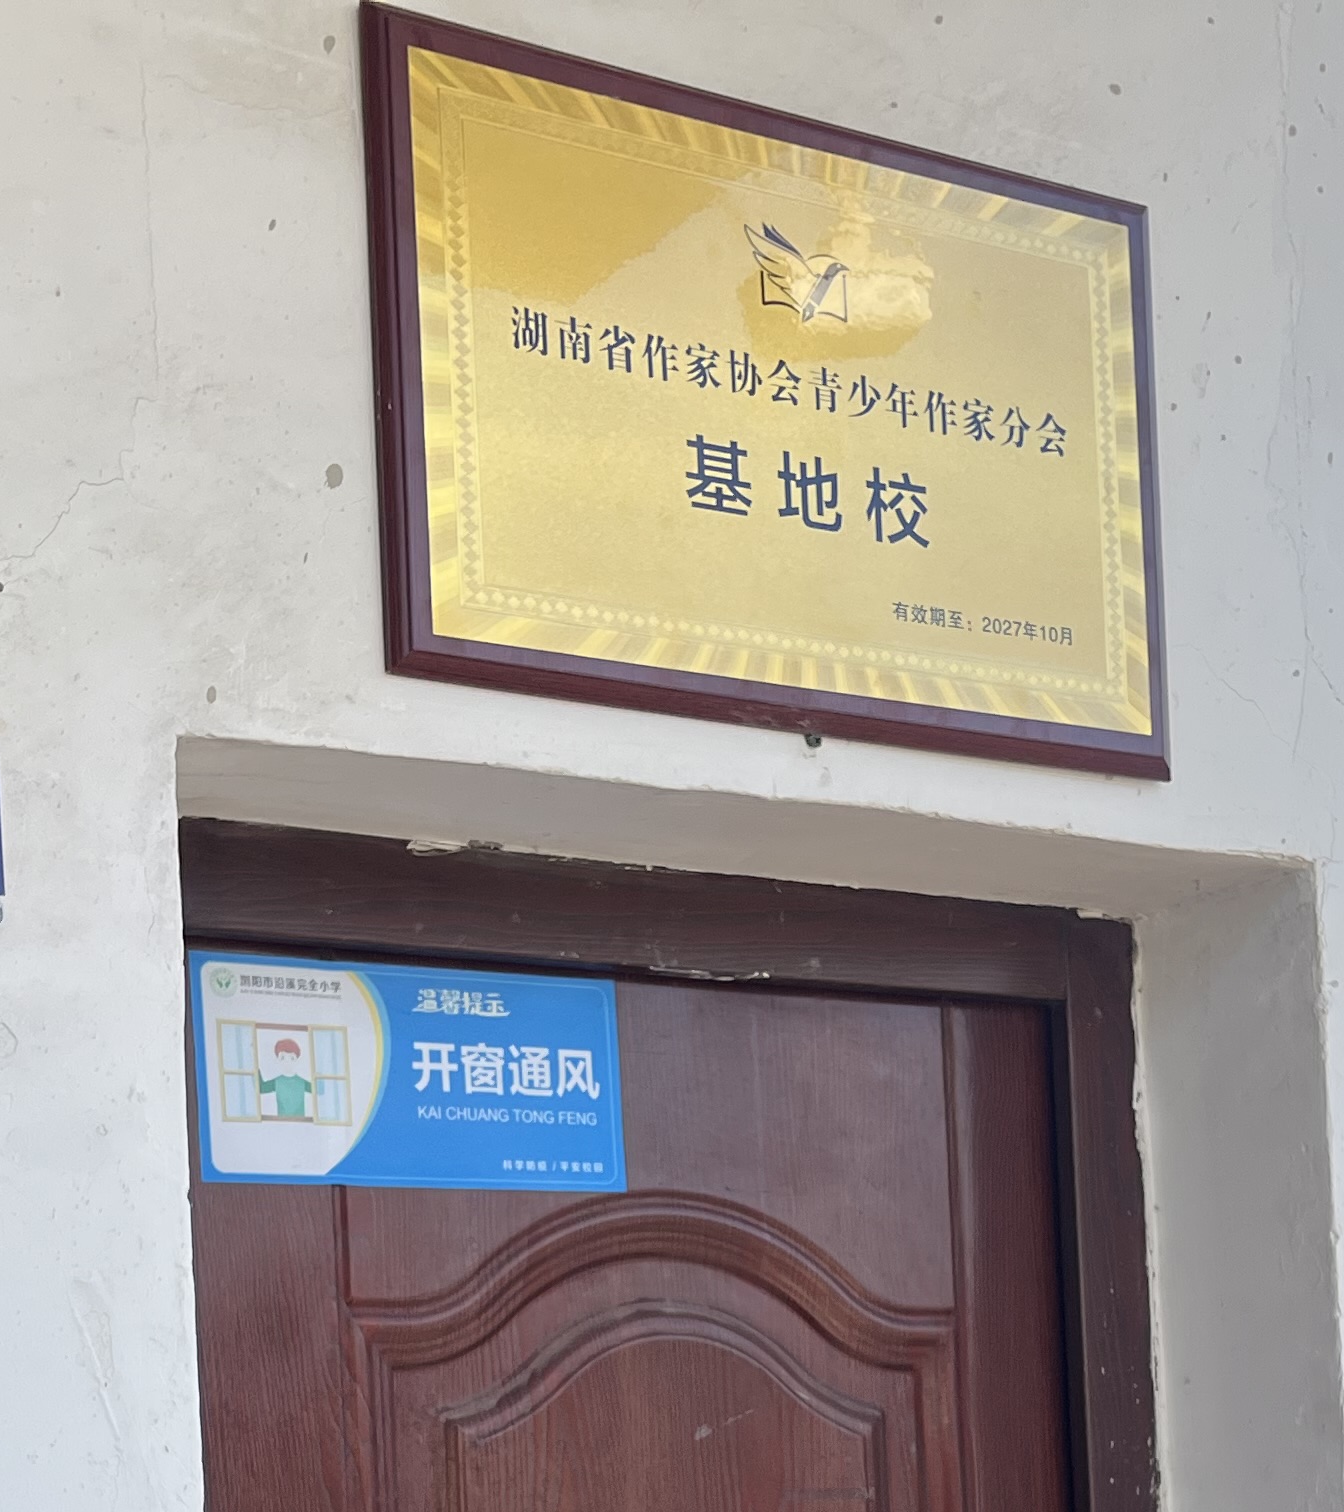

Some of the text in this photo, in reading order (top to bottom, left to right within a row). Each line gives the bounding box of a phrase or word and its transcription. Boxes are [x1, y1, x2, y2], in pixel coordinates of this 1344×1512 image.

[510, 305, 1068, 459] 湖南省作家协会青少年作家分会
[685, 433, 932, 549] 基地校
[411, 988, 511, 1018] 温馨提示
[411, 1040, 601, 1100] 开窗通风
[417, 1105, 598, 1127] KAI CHUANG TONG FENG
